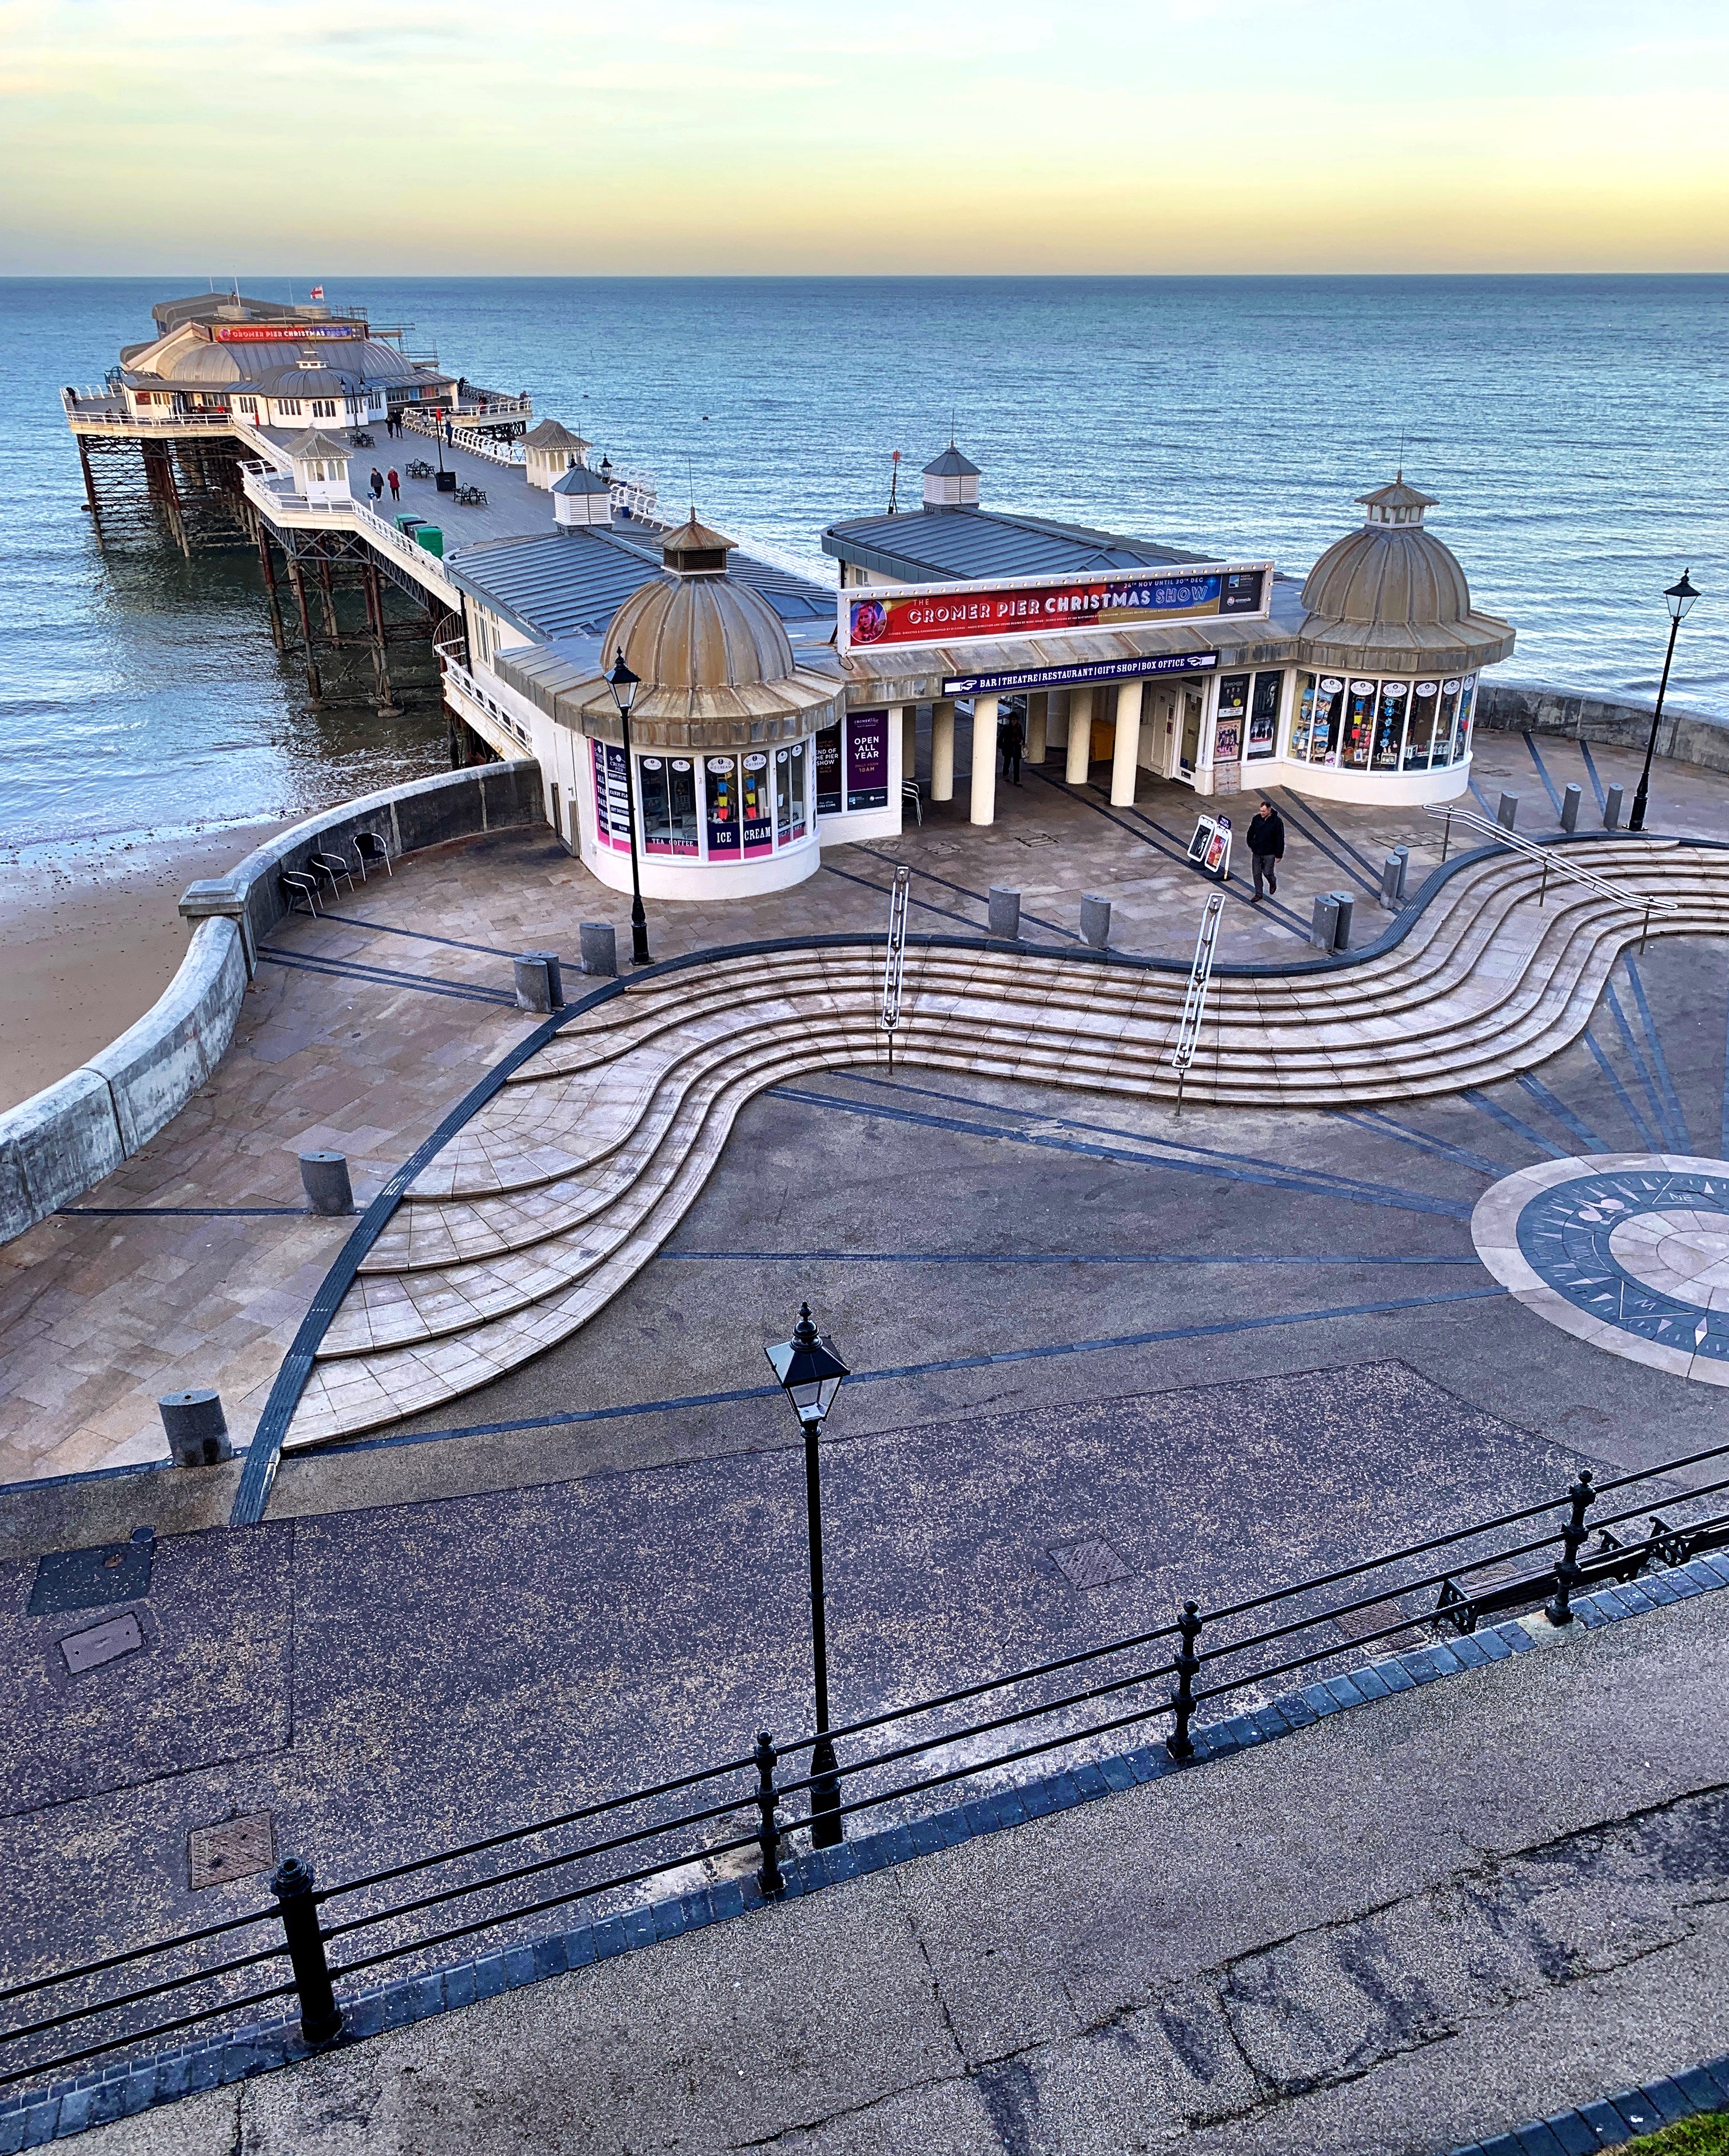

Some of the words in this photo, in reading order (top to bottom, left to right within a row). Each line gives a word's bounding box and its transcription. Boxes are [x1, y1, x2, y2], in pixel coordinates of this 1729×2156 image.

[284, 329, 325, 337] CHRISTMAS
[907, 603, 990, 624] CROMER
[997, 599, 1040, 617] PIER
[1044, 590, 1150, 613] CHRISTMAS
[1156, 585, 1208, 604] SHOW
[979, 678, 997, 688] BAR
[1002, 673, 1038, 686] THEATRE
[1042, 667, 1093, 681] RESTAURANT
[1097, 665, 1116, 675] GIFT
[1117, 662, 1138, 673] SHOP
[1141, 661, 1156, 671] BOX
[1158, 659, 1185, 668] OFFICE
[854, 736, 879, 745] OPEN
[858, 744, 875, 752] ALL
[854, 751, 879, 760] YEAR
[609, 761, 626, 769] CROME
[716, 832, 732, 843] ICE
[744, 826, 771, 841] CREAM
[1668, 1193, 1695, 1202] NE
